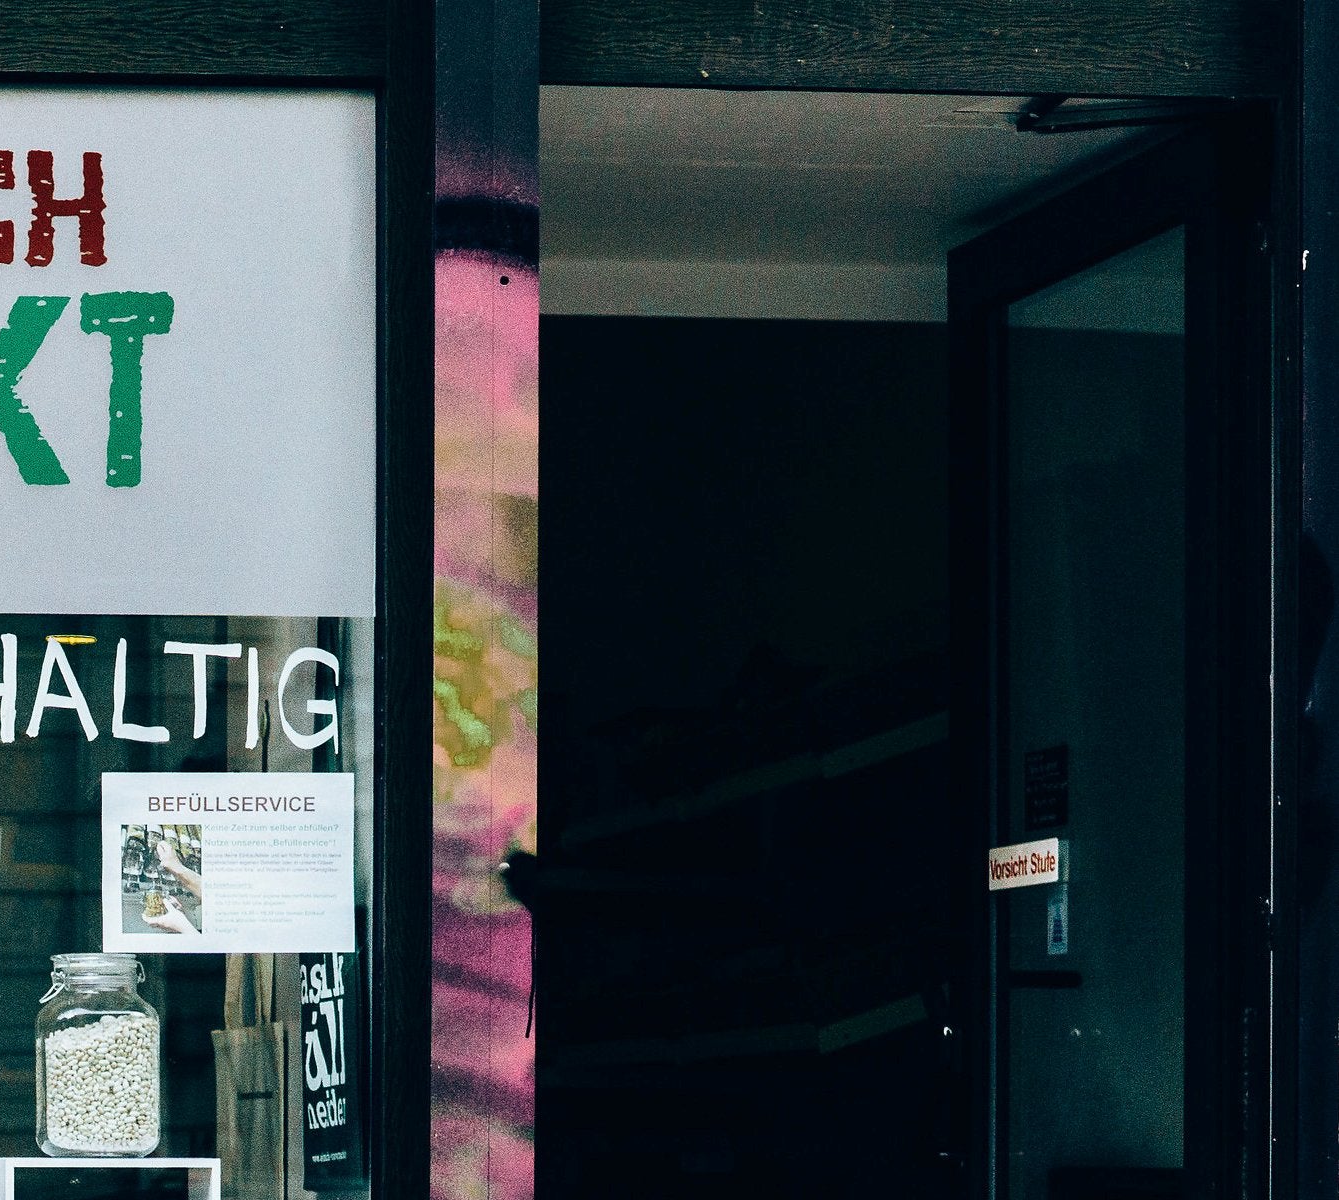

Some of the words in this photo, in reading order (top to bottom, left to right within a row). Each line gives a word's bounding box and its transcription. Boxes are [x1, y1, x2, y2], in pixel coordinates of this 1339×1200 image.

[148, 792, 315, 813] BEFÜLLSERVICE
[231, 824, 247, 832] Zeit
[270, 824, 296, 832] selber
[299, 824, 339, 832] abfüllen?
[205, 839, 228, 848] Nutze
[232, 840, 266, 848] unseren
[990, 857, 1028, 880] Vorsicht
[1030, 851, 1055, 874] Stufe
